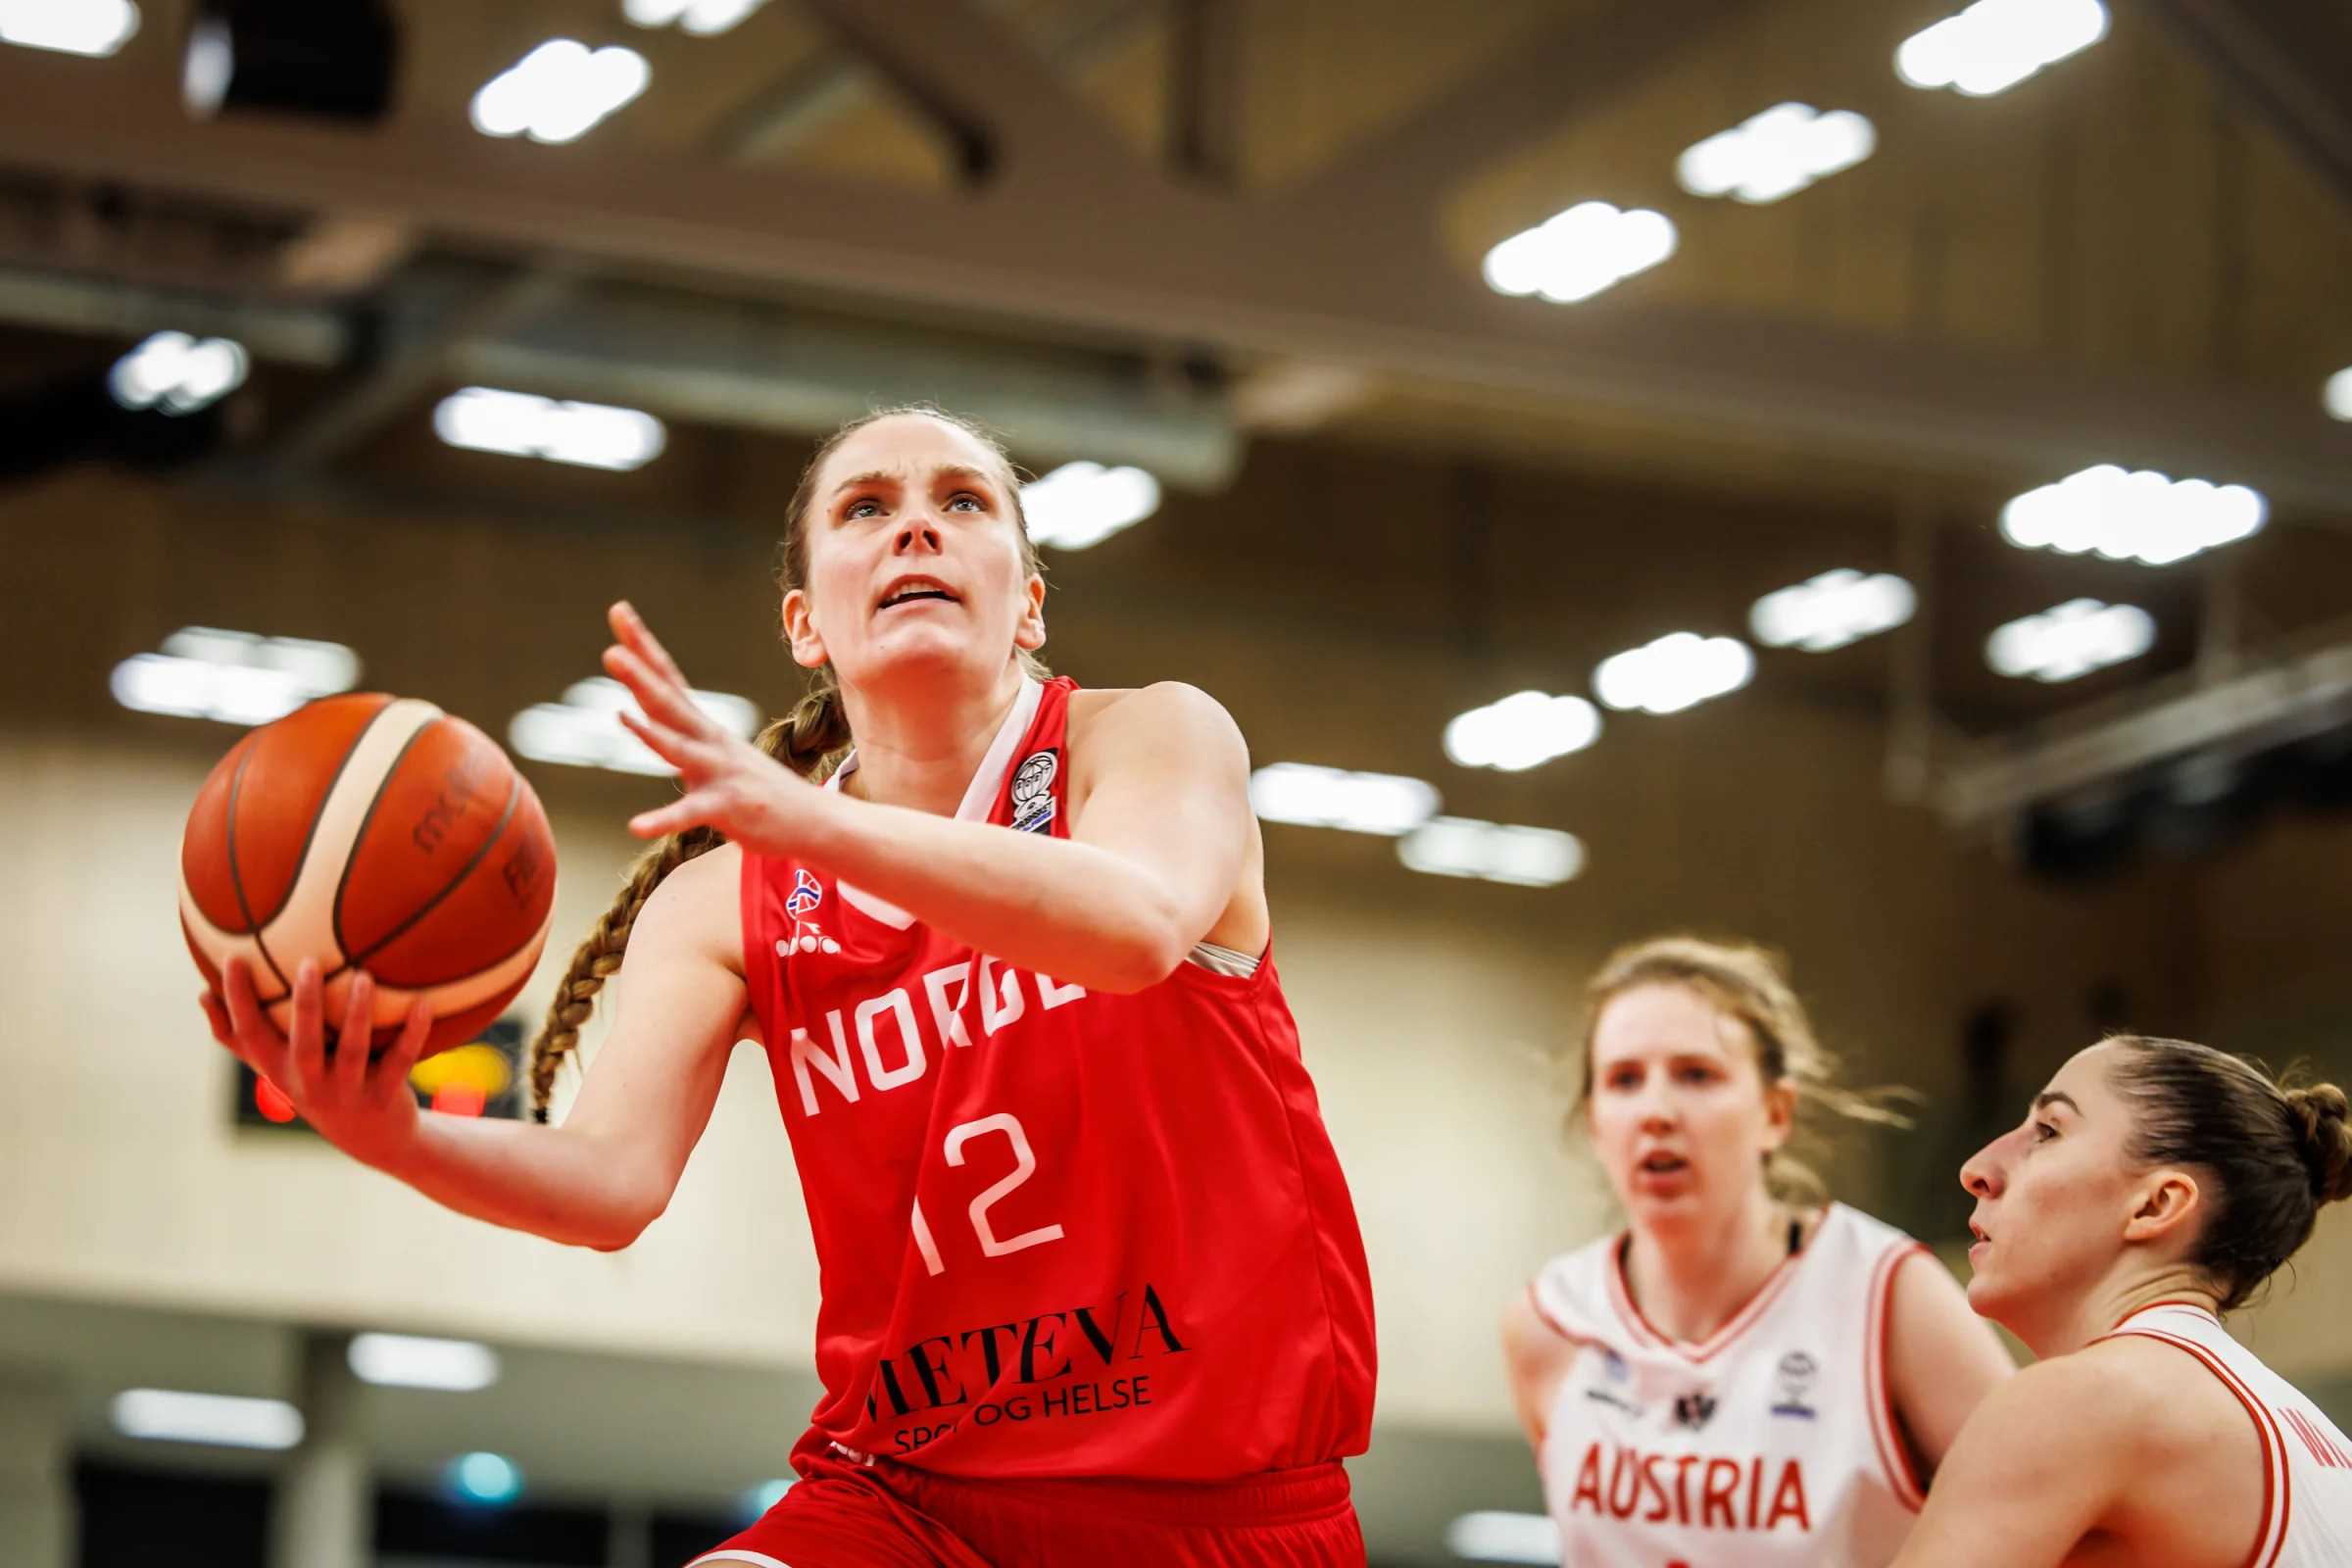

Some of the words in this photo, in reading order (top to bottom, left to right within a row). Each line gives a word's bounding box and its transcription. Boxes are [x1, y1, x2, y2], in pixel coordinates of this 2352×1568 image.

[911, 1113, 1064, 1277] 12
[974, 1396, 1030, 1426] OG
[1044, 1375, 1152, 1417] HELSE
[1573, 1443, 1810, 1532] AUSTRIA
